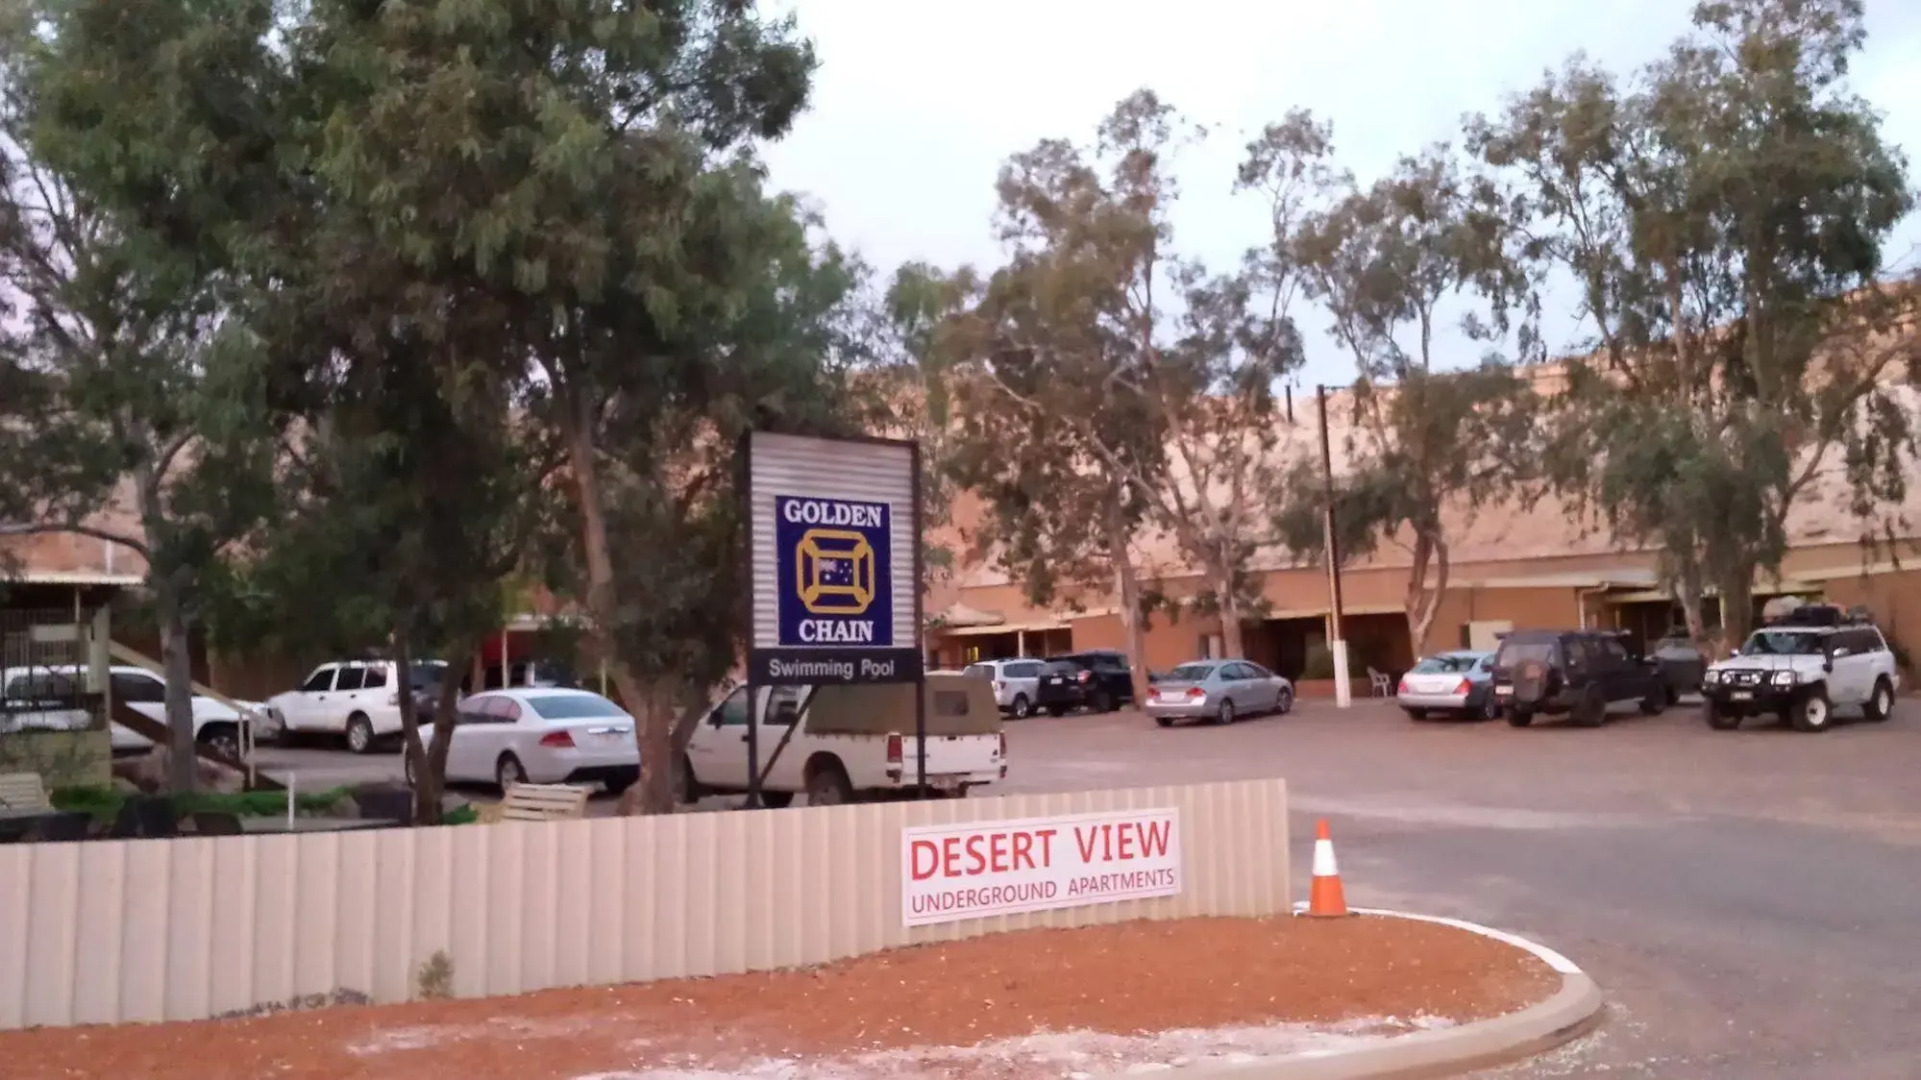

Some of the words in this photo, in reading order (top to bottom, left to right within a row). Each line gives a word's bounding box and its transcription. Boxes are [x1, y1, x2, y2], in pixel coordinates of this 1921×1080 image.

[784, 500, 882, 527] GOLDEN
[799, 620, 873, 642] CHAIN
[769, 659, 854, 679] Swimming
[861, 659, 894, 677] Pool
[911, 829, 1057, 881] DESERT
[1075, 820, 1170, 863] VIEW
[912, 881, 1057, 913] UNDERGROUND
[1068, 869, 1174, 896] APARTMENTS
